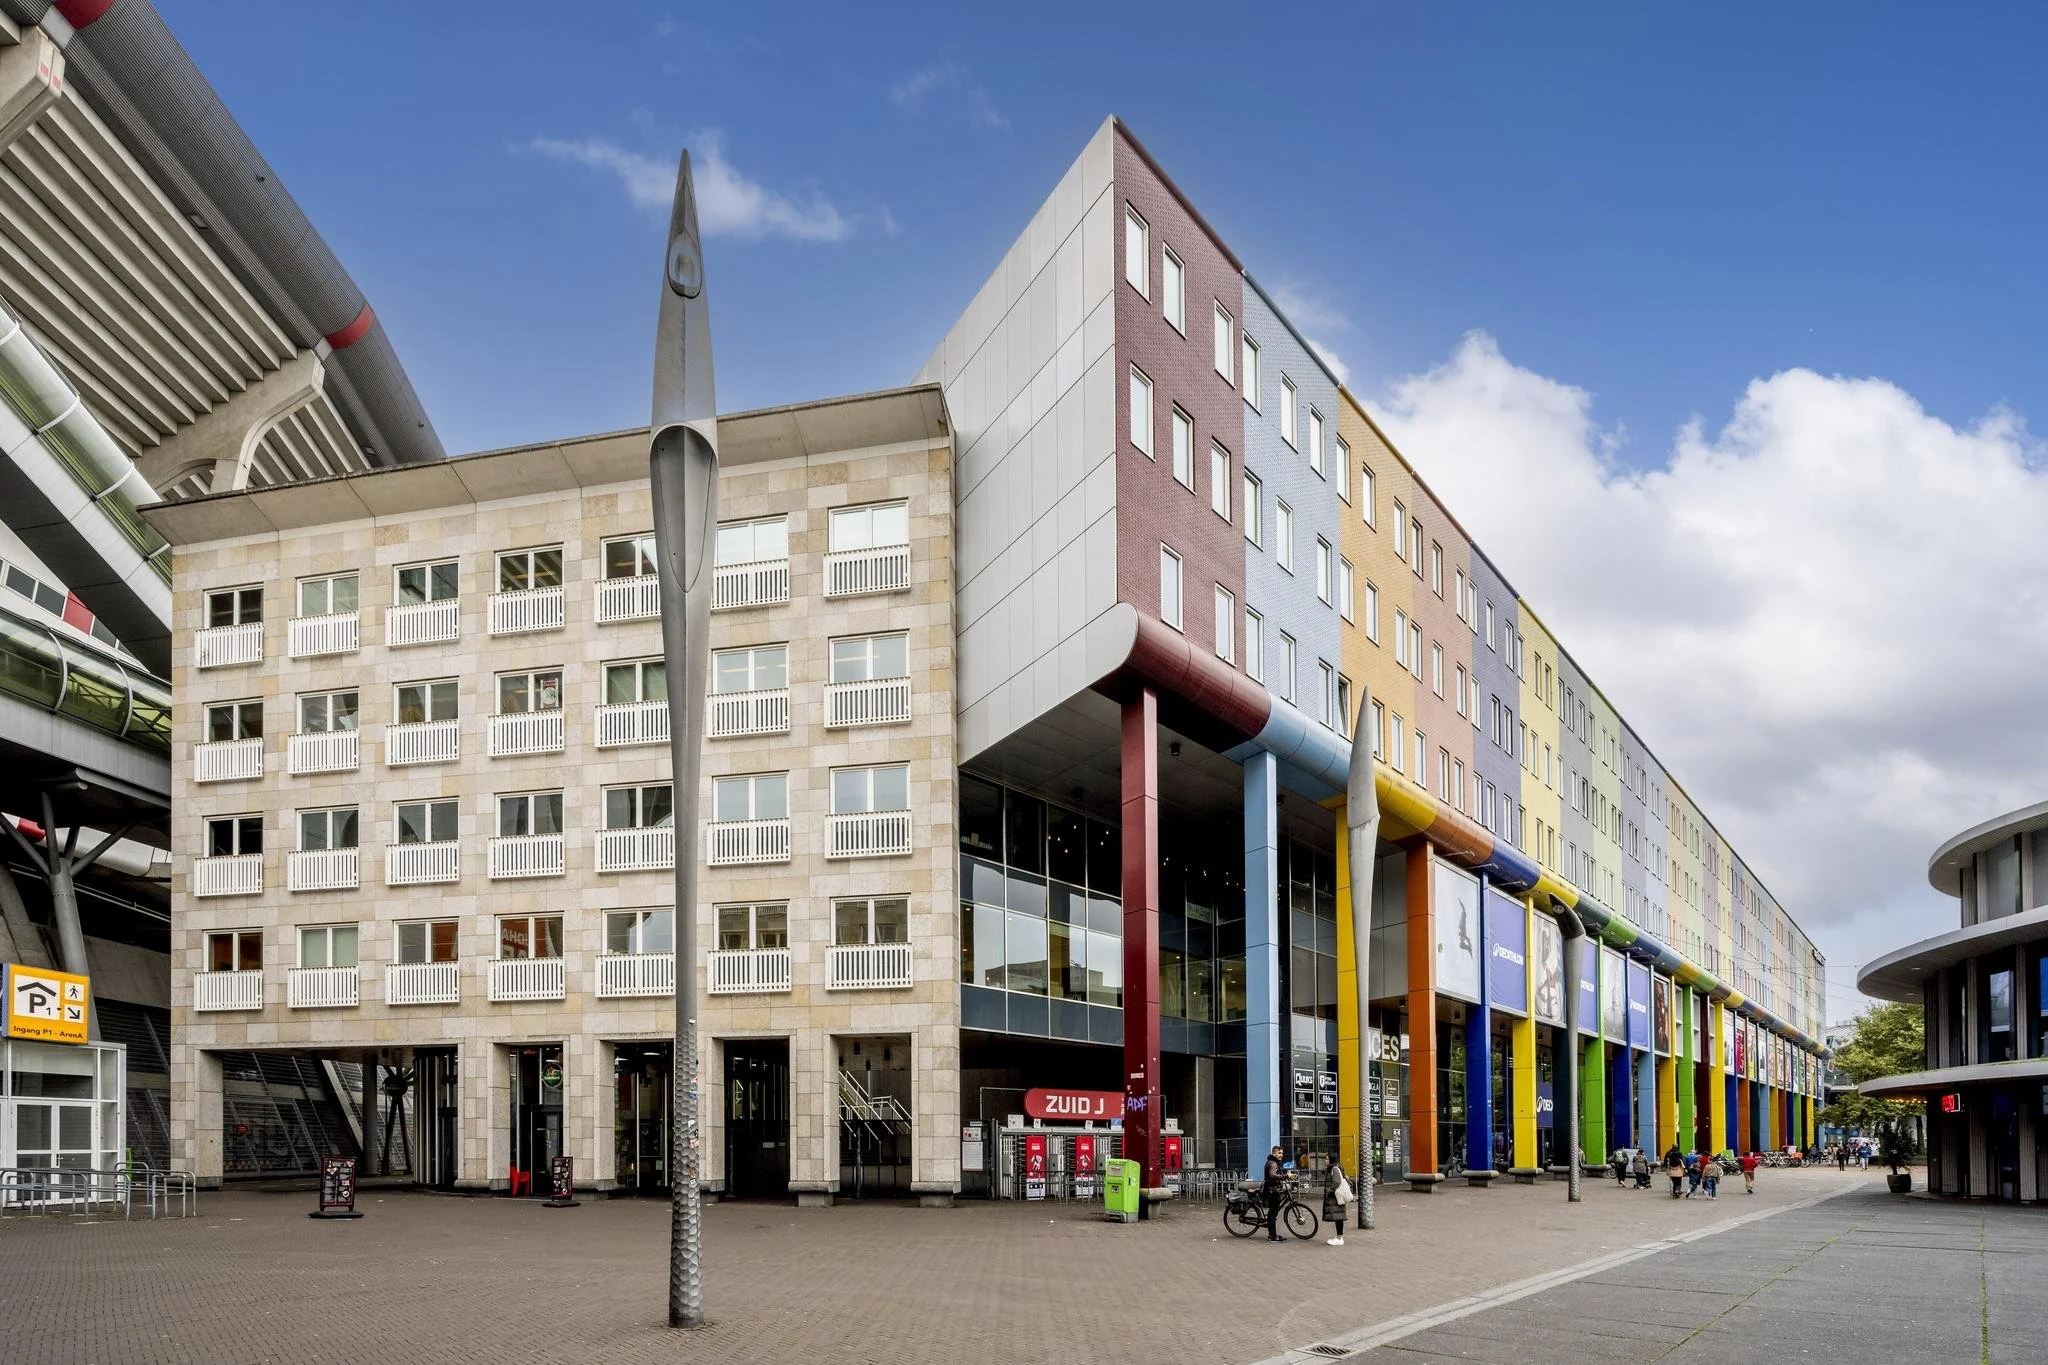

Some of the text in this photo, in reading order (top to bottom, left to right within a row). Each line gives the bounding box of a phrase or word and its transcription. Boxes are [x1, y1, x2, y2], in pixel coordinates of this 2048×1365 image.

[13, 1025, 41, 1036] Ingang
[43, 1028, 52, 1036] P1
[1045, 1095, 1091, 1115] ZUID
[1094, 1097, 1105, 1115] J
